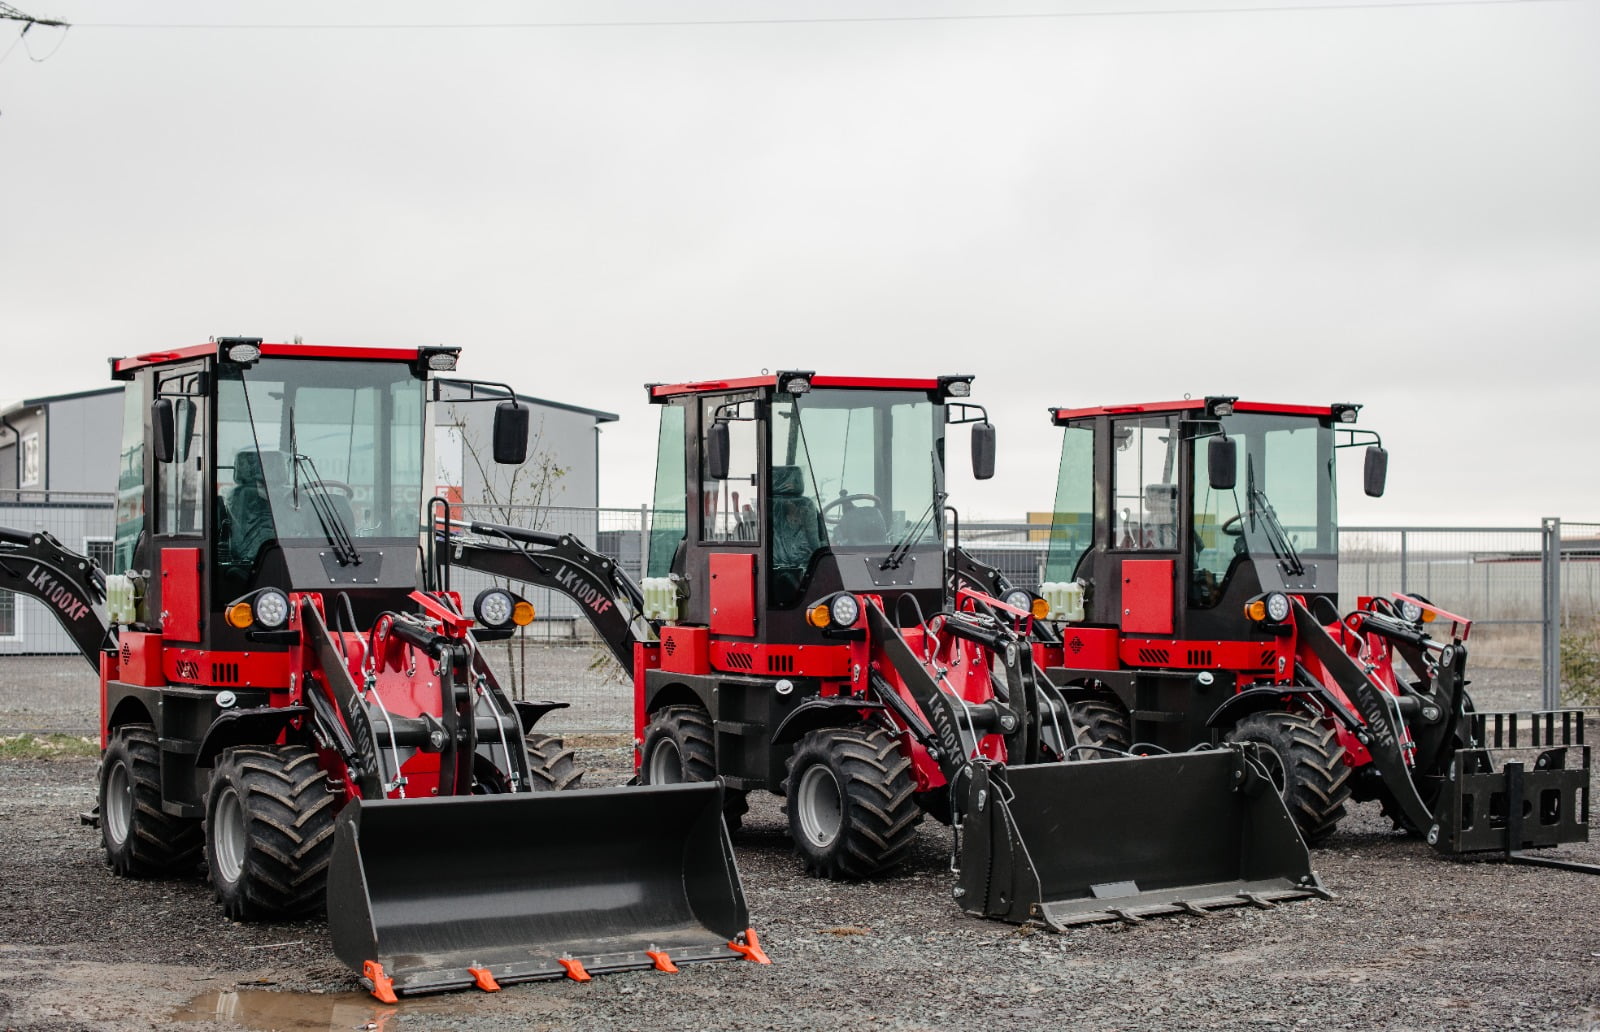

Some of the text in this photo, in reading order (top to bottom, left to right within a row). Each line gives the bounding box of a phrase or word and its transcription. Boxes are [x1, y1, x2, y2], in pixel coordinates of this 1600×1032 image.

[27, 565, 89, 621] LK100XF
[555, 565, 612, 614] LK100XF
[348, 694, 377, 774] LK100XF
[928, 693, 964, 765] LK100XF
[1357, 682, 1394, 747] LK100XF
